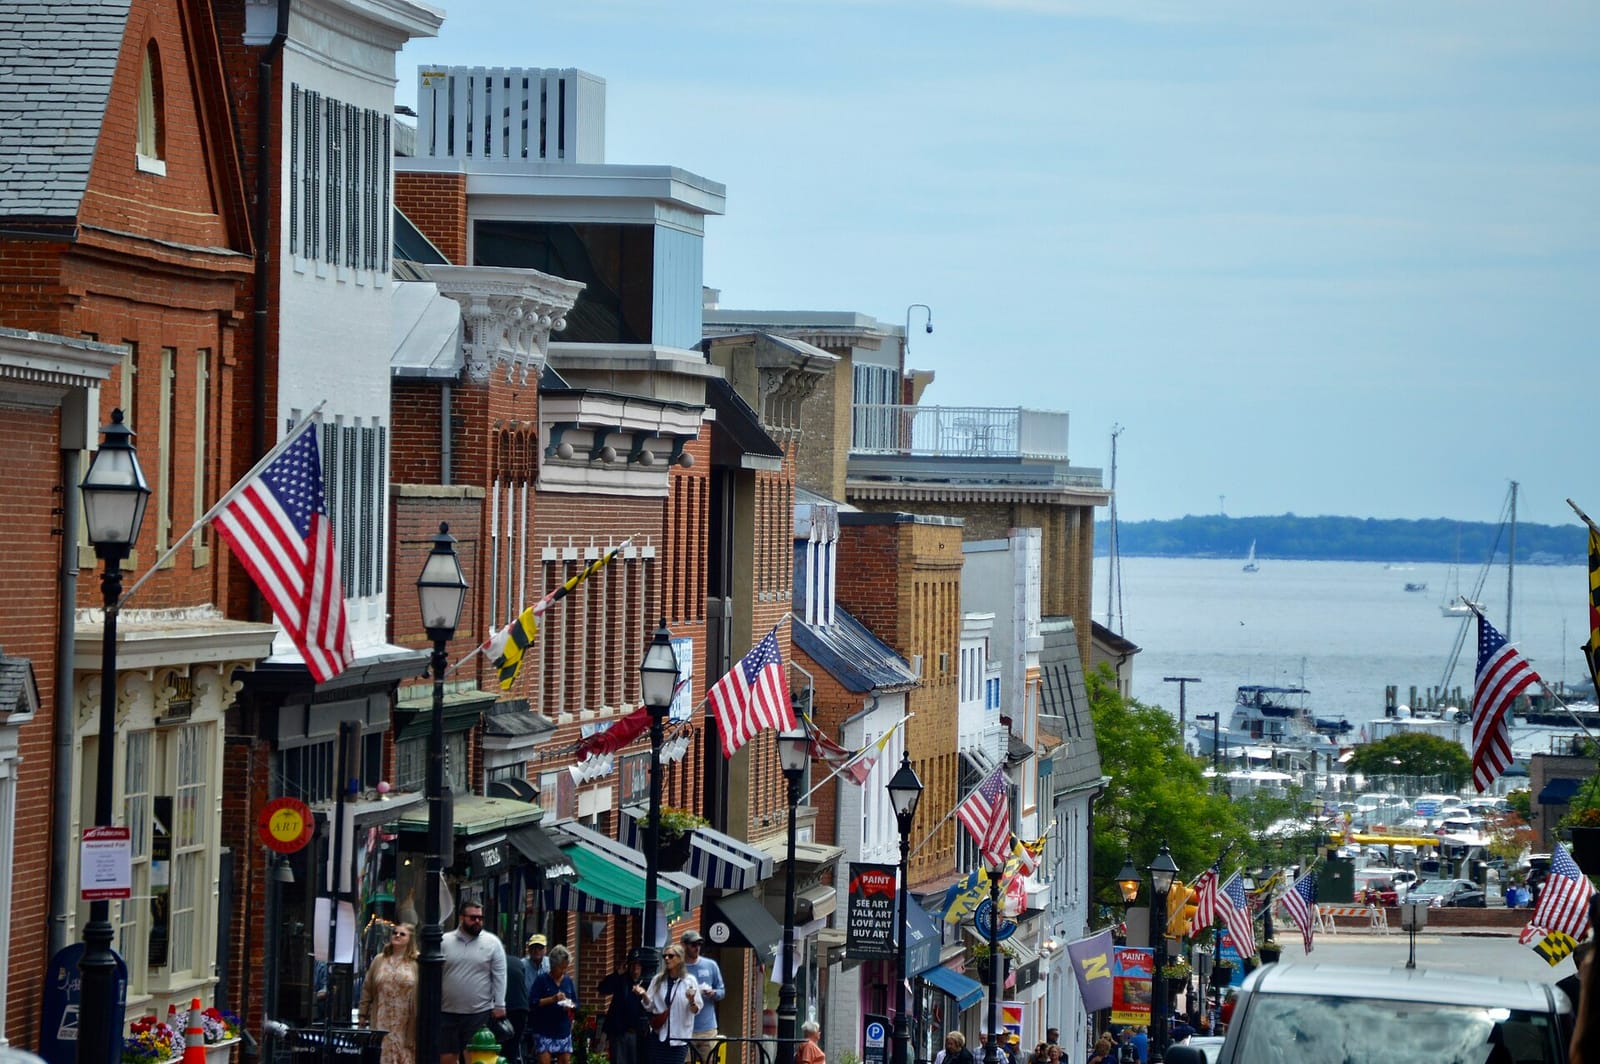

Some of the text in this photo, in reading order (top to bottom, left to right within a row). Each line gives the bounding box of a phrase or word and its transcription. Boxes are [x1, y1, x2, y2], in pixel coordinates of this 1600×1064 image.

[273, 822, 299, 832] ART
[862, 875, 891, 885] PAINT
[856, 899, 889, 909] SEE ART
[852, 909, 893, 919] TALK ART
[851, 919, 892, 929] LOVE ART
[716, 925, 723, 936] B
[853, 929, 890, 939] BUY ART
[1122, 951, 1146, 961] PAINT
[1082, 953, 1110, 981] N
[872, 1026, 880, 1038] P
